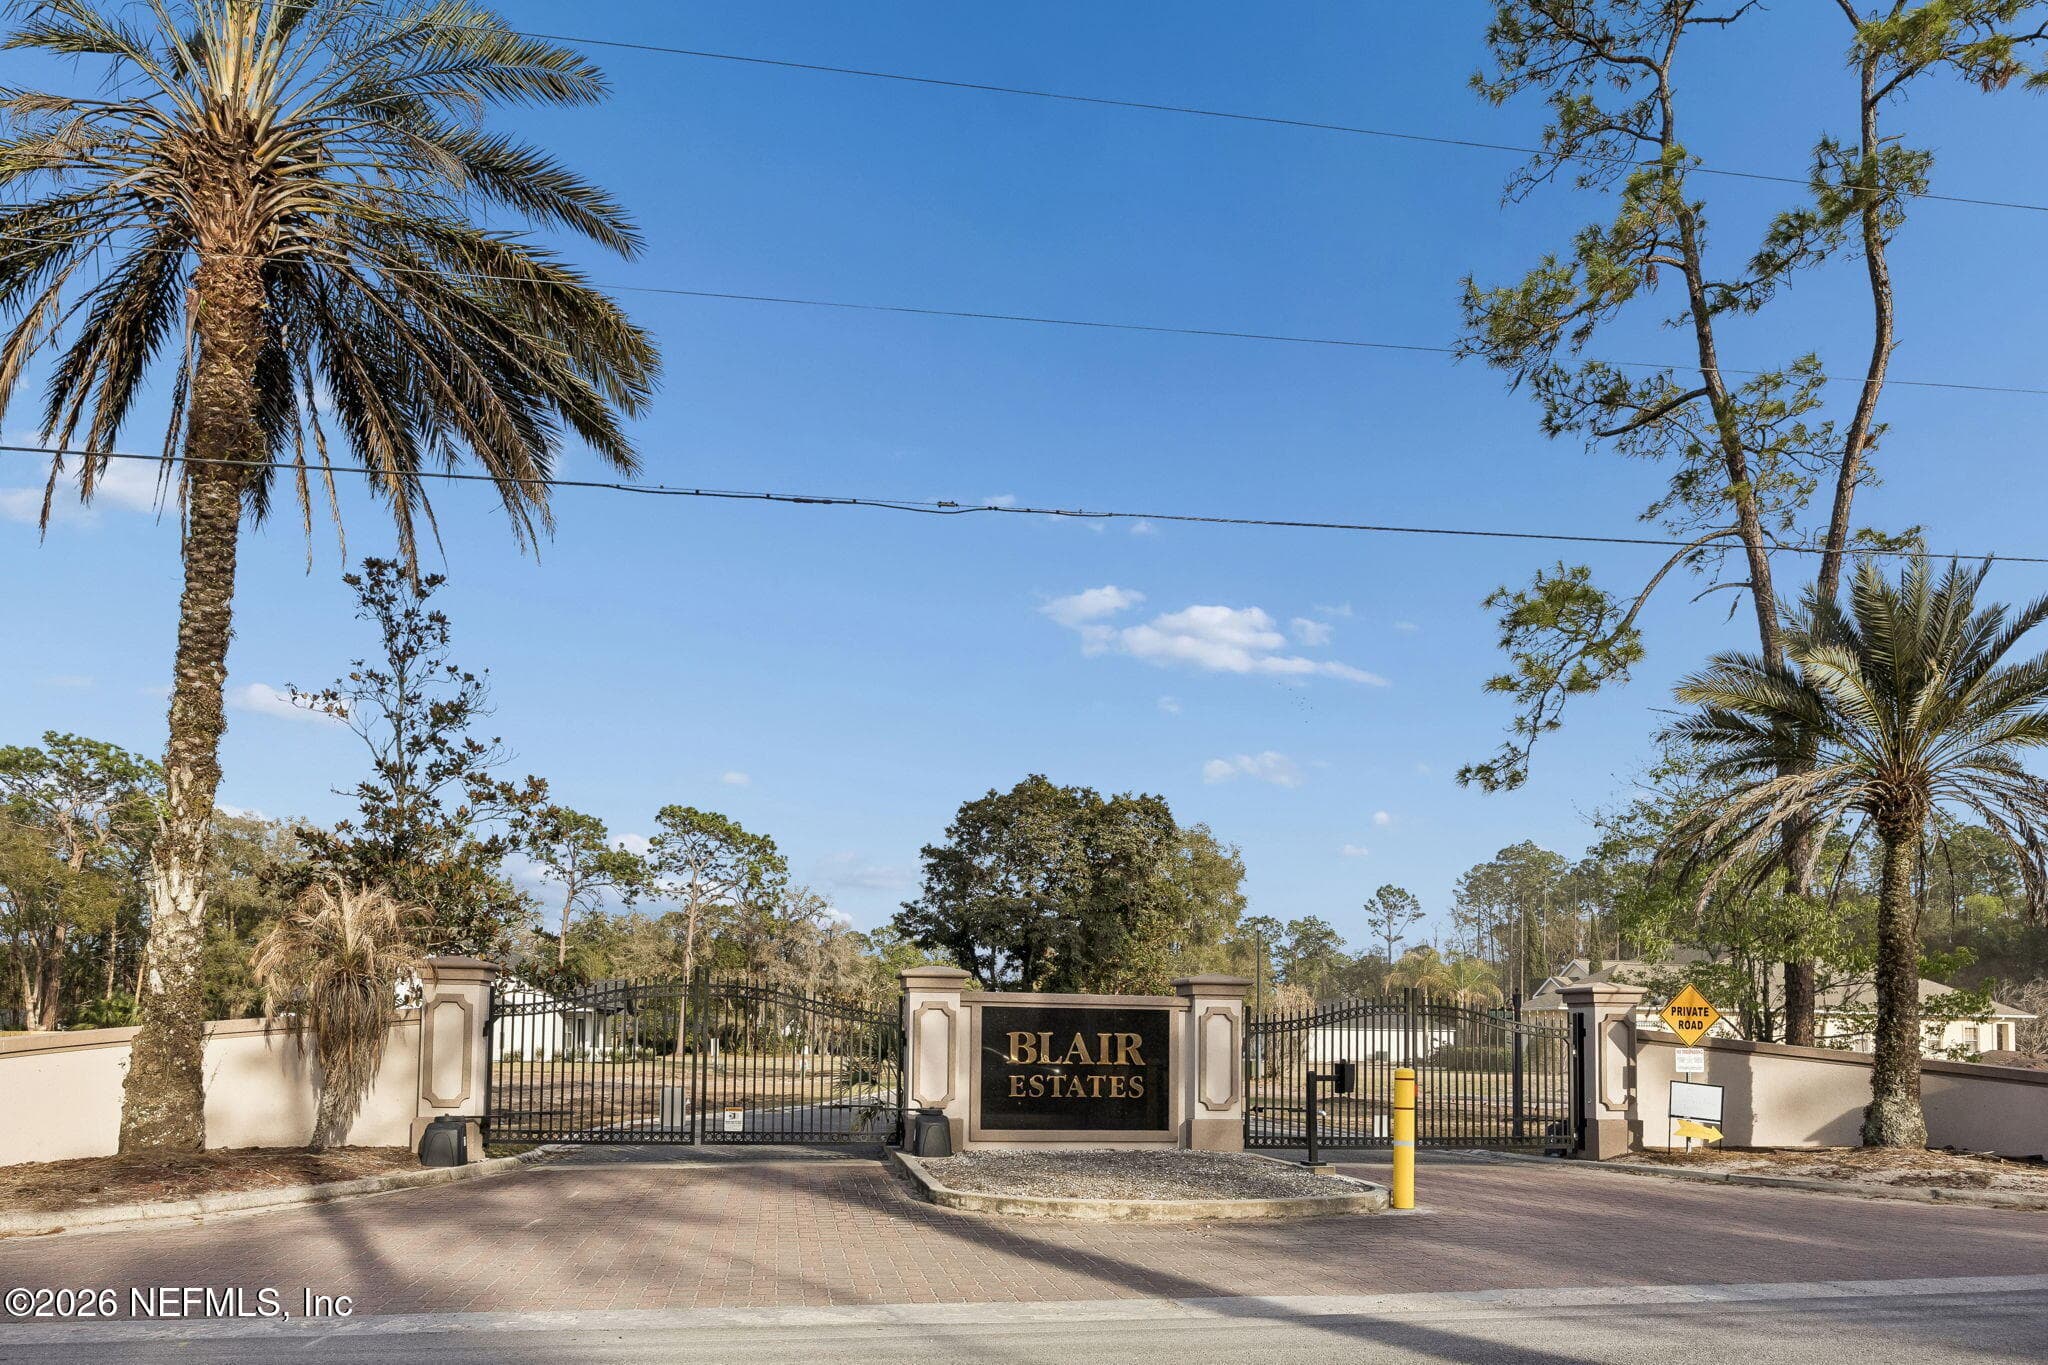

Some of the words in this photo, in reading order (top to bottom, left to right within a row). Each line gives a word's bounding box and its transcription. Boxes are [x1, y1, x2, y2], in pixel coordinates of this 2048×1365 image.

[1671, 1006, 1709, 1017] PRIVATE
[1678, 1020, 1703, 1030] ROAD
[1006, 1031, 1146, 1066] BLAIR
[1008, 1075, 1145, 1099] ESTATES
